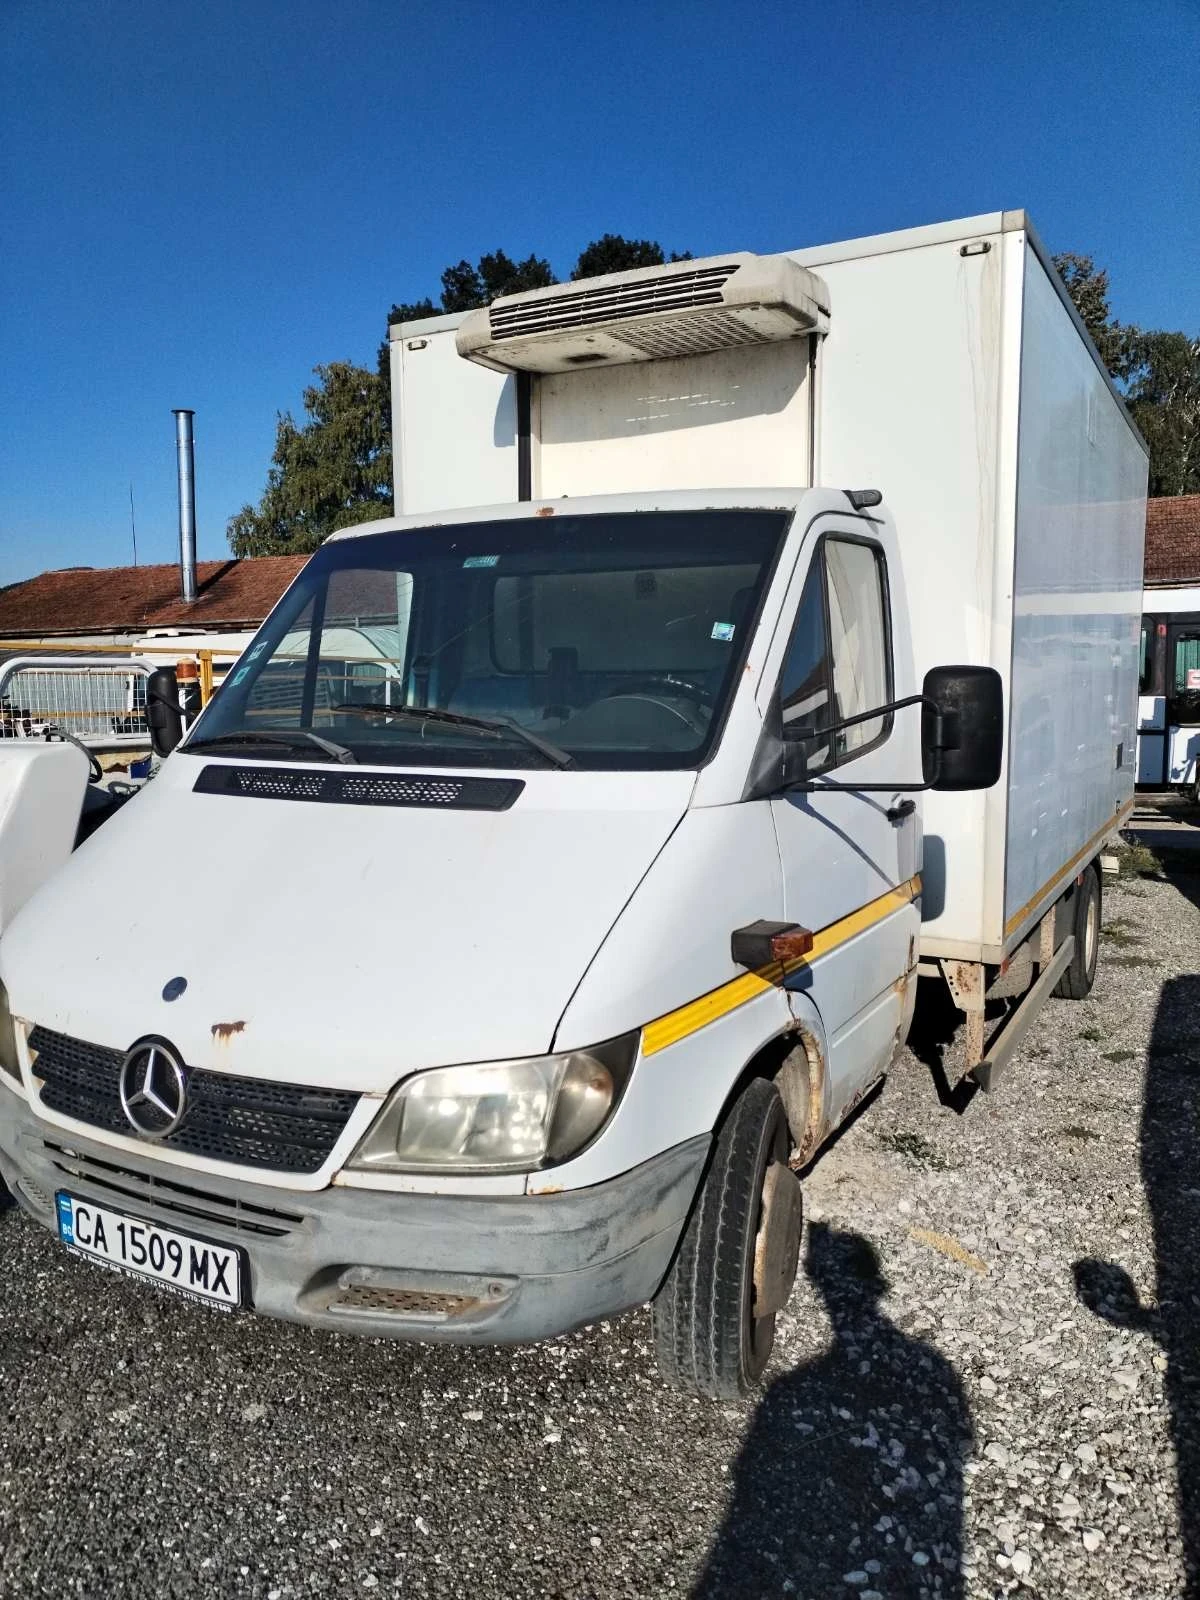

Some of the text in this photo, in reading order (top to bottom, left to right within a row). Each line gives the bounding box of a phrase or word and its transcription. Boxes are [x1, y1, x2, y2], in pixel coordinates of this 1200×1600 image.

[62, 1223, 73, 1237] BG
[75, 1207, 108, 1253] CA
[117, 1223, 183, 1278] 1509
[190, 1245, 231, 1296] MX
